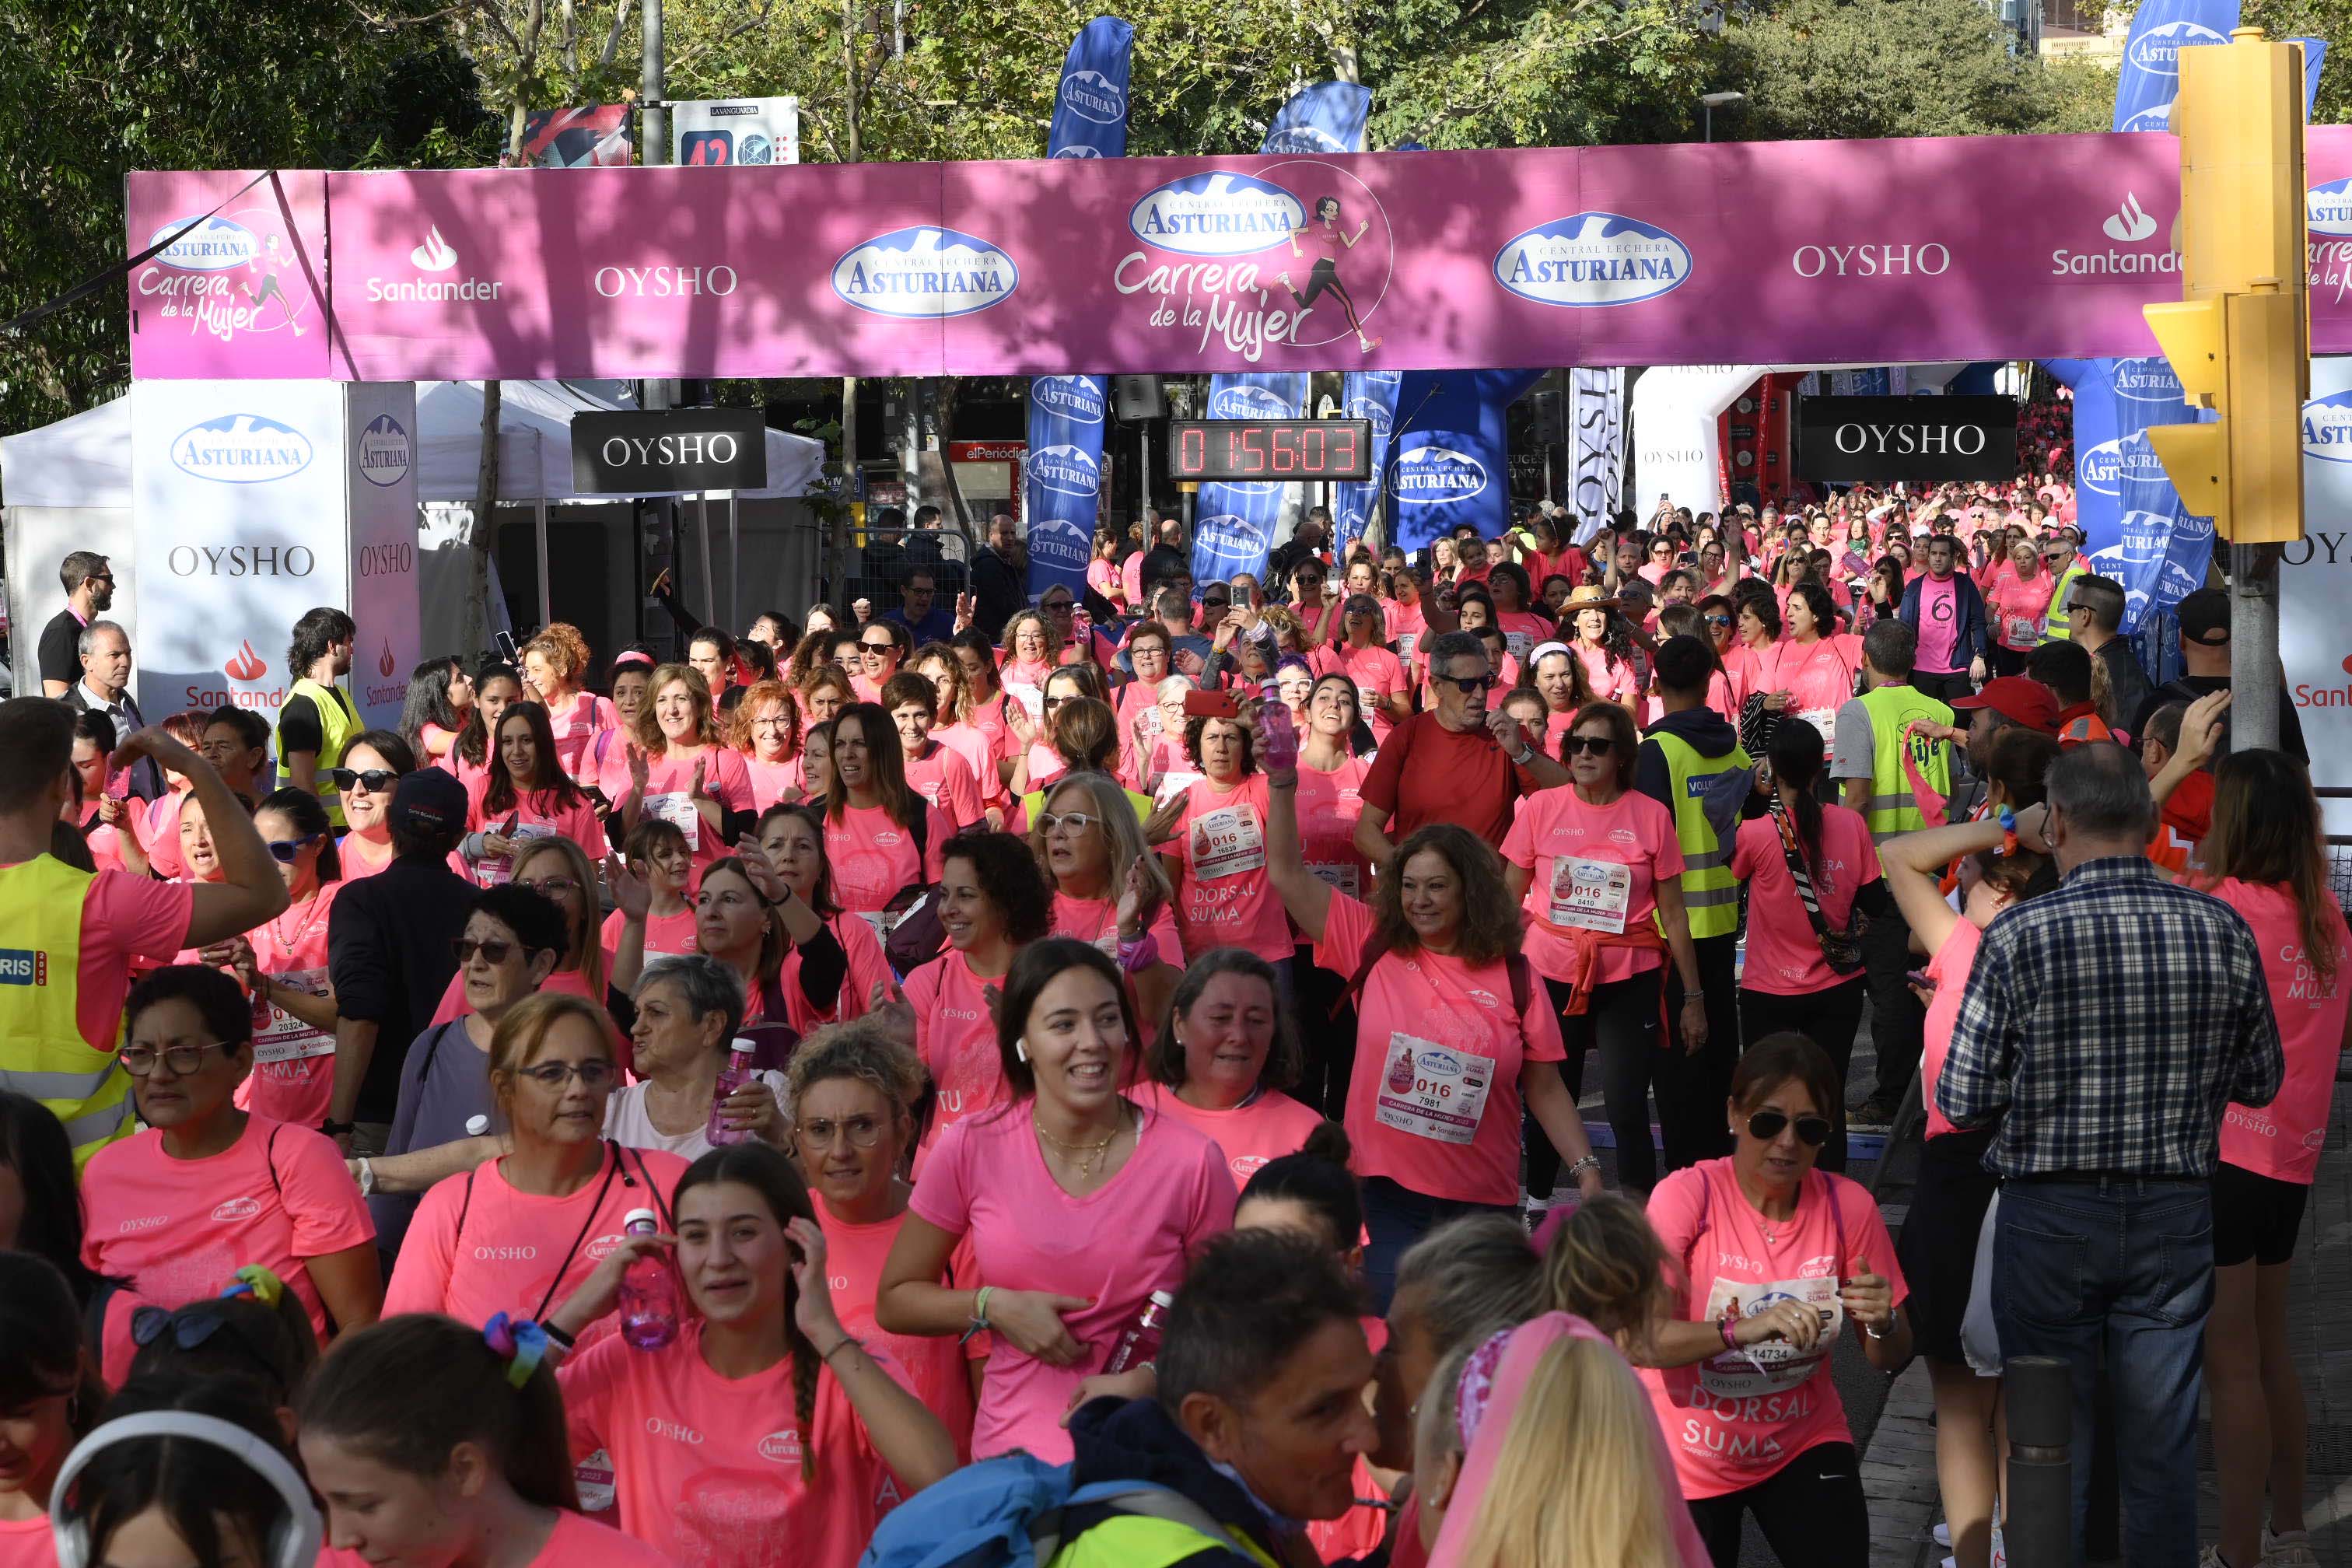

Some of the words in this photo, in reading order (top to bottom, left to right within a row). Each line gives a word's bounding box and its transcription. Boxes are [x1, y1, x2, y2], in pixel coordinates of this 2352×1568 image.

[2137, 41, 2178, 61] ASTU
[1143, 203, 1292, 234] ASTURIANA
[1540, 244, 1602, 255] CENTRAL
[1607, 243, 1670, 254] LECHERA
[1509, 249, 1677, 284] ASTURIANA
[1792, 243, 1950, 278] OYSHO
[138, 267, 229, 296] Carrera
[594, 265, 737, 297] OYSHO
[846, 261, 1005, 294] ASTURIANA
[1114, 252, 1260, 295] Carrera
[2324, 264, 2338, 285] la
[367, 277, 502, 302] Santander
[161, 297, 178, 317] de
[181, 297, 193, 317] la
[191, 293, 264, 342] Mujer
[1150, 297, 1176, 327] de
[1182, 296, 1202, 327] la
[1198, 289, 1314, 362] Mujer
[1039, 383, 1101, 418] ASTURIANA
[1835, 423, 1986, 455] OYSHO
[182, 440, 303, 466] ASTURIANA
[362, 447, 408, 468] ASTURIANA
[603, 433, 737, 467] OYSHO
[1644, 449, 1703, 464] OYSHO
[1034, 457, 1097, 490] ASTURIANA
[1392, 468, 1479, 491] ASTURIANA
[2280, 532, 2352, 565] OY
[168, 544, 316, 577] OYSHO
[360, 542, 411, 577] OYSHO
[1207, 818, 1234, 829] ASTURIANA
[1553, 828, 1584, 836] OYSHO
[1213, 832, 1237, 847] 016
[1218, 845, 1237, 855] 16839
[1577, 870, 1605, 880] ASTURIANA
[1195, 881, 1255, 903] DORSAL
[1574, 885, 1601, 898] 016
[1190, 905, 1240, 922] SUMA
[1552, 914, 1576, 922] OYSHO
[257, 1034, 282, 1043] CARRERA
[299, 1030, 318, 1038] MUJER
[278, 1021, 304, 1031] 20324
[257, 1047, 285, 1057] OYSHO
[1419, 1058, 1458, 1074] ASTURIANA
[1416, 1078, 1451, 1097] 016
[938, 1090, 961, 1112] TU
[1388, 1101, 1416, 1113] CARRERA
[1433, 1111, 1454, 1122] MUJER
[1419, 1096, 1440, 1108] 7981
[1384, 1111, 1413, 1126] OYSHO
[1437, 1125, 1469, 1138] Santander
[2226, 1111, 2277, 1138] OYSHO
[120, 1215, 169, 1234] OYSHO
[474, 1246, 537, 1260] OYSHO
[1807, 1294, 1830, 1303] SUMA
[1752, 1349, 1787, 1360] 14734
[1711, 1378, 1752, 1389] OYSHO
[1689, 1384, 1810, 1423] DORSAL
[1682, 1419, 1784, 1457] SUMA
